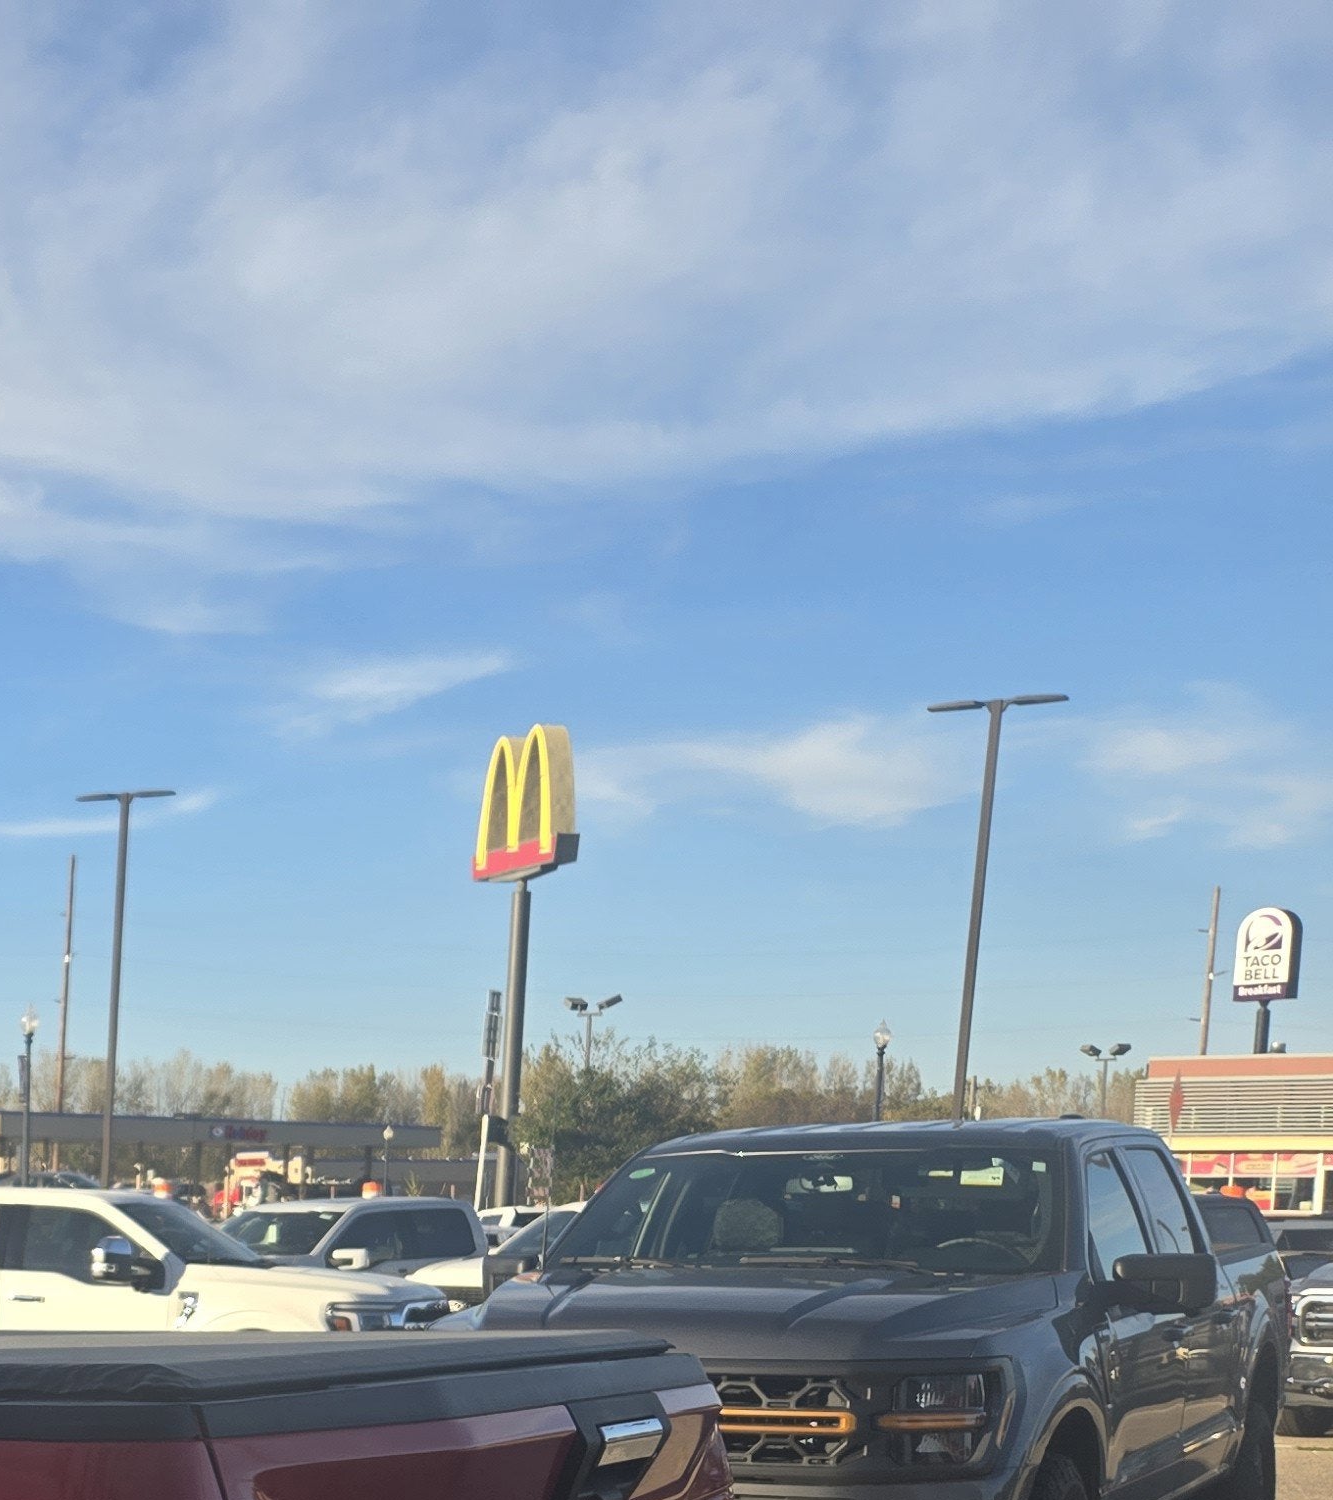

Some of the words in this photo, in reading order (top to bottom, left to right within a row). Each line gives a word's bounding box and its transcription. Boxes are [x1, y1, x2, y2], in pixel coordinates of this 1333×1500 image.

[1243, 954, 1282, 967] TACO
[1244, 968, 1279, 981] BELL
[1238, 984, 1282, 996] Breakfast
